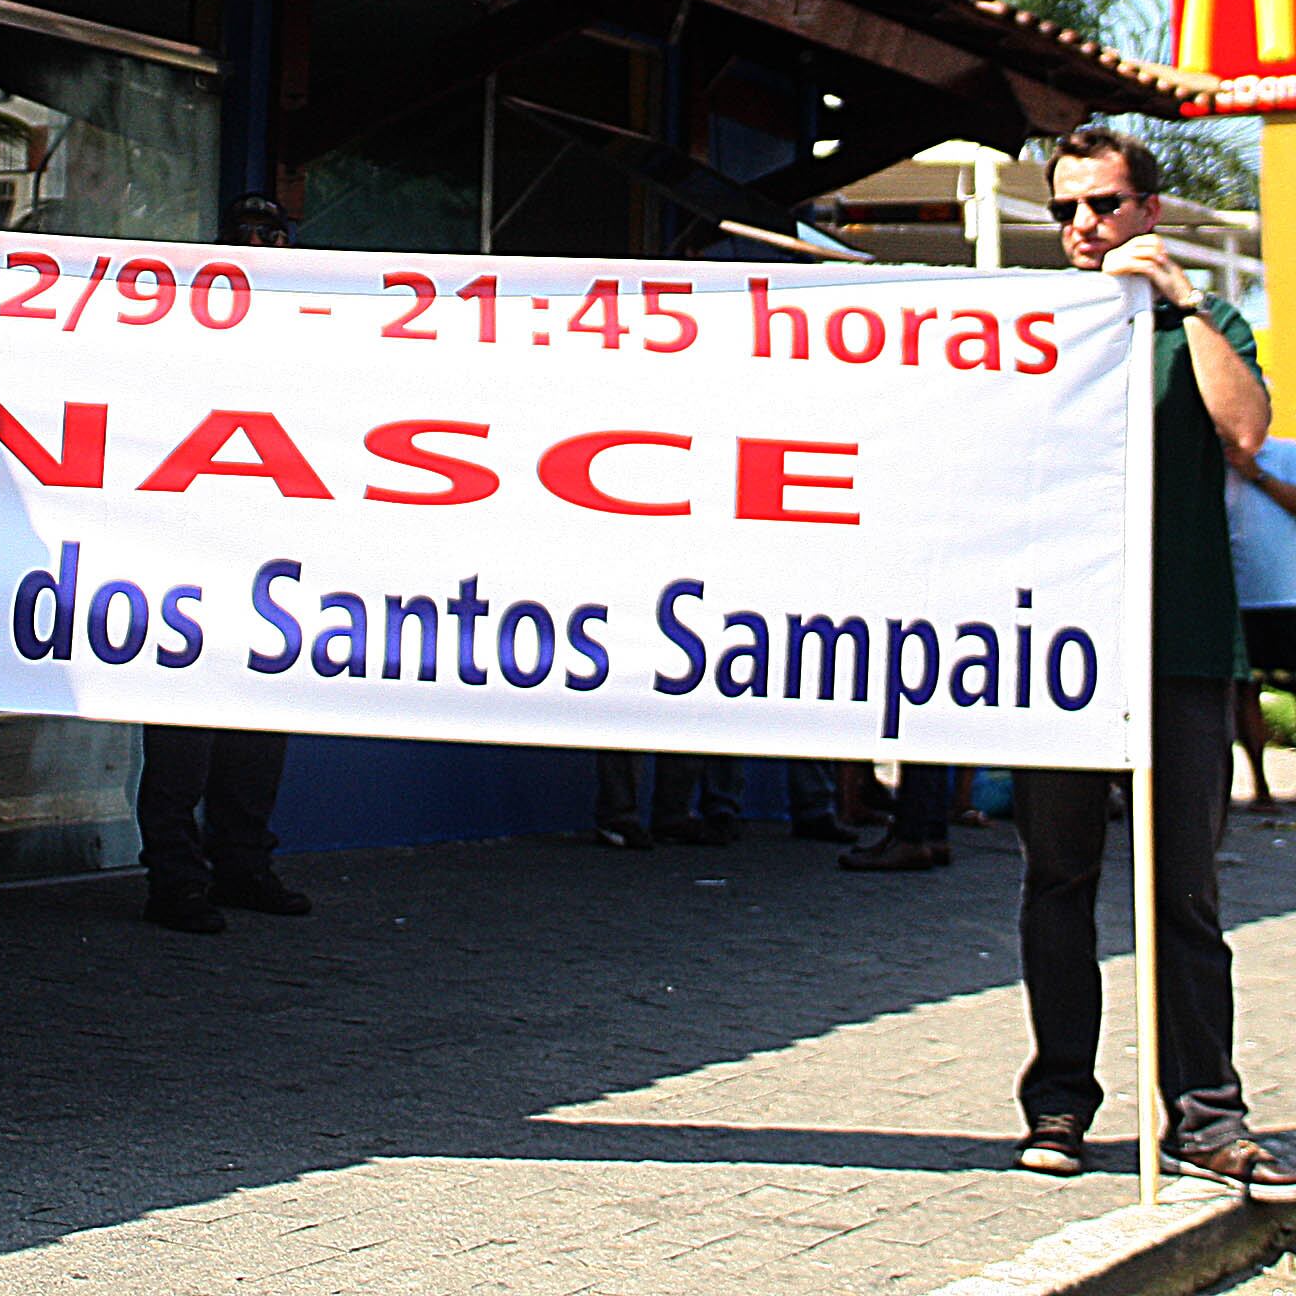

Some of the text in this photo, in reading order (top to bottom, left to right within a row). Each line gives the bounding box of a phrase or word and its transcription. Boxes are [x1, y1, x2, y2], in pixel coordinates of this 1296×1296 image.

[380, 271, 699, 354] 21:45
[746, 277, 1060, 376] horas
[12, 540, 203, 669] dos
[247, 558, 609, 696] Santos
[653, 577, 1100, 740] Sampaio
